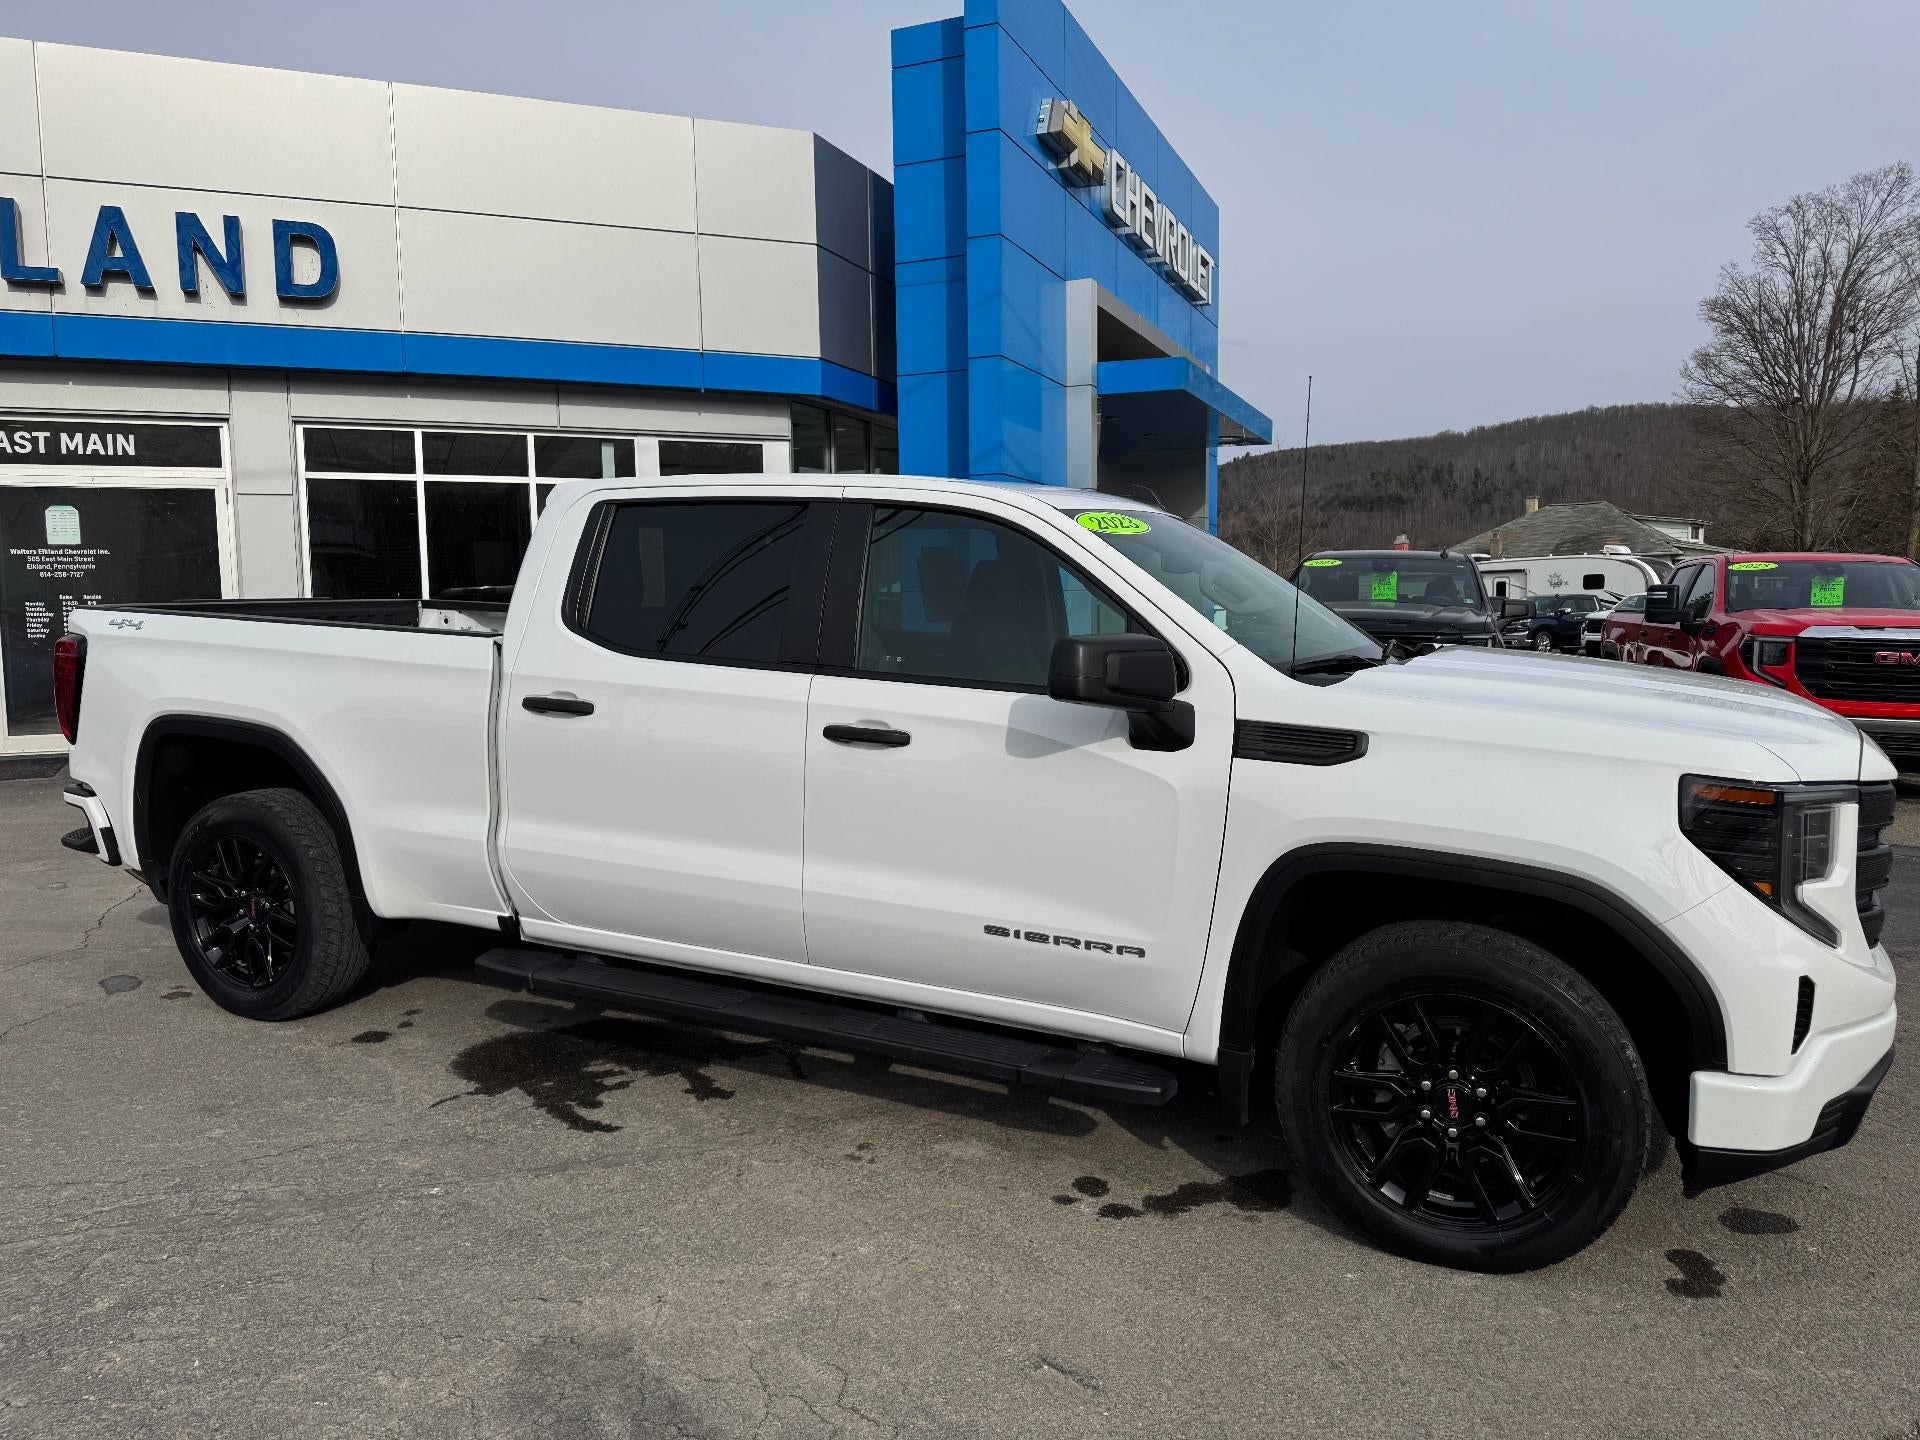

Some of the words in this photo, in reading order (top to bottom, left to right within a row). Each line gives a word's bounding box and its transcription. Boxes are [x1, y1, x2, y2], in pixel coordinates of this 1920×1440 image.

[1106, 148, 1214, 305] CHEVROLET
[0, 196, 340, 299] LAND
[60, 433, 136, 456] MAIN
[1088, 516, 1139, 530] 2023
[983, 924, 1146, 959] SIERRA
